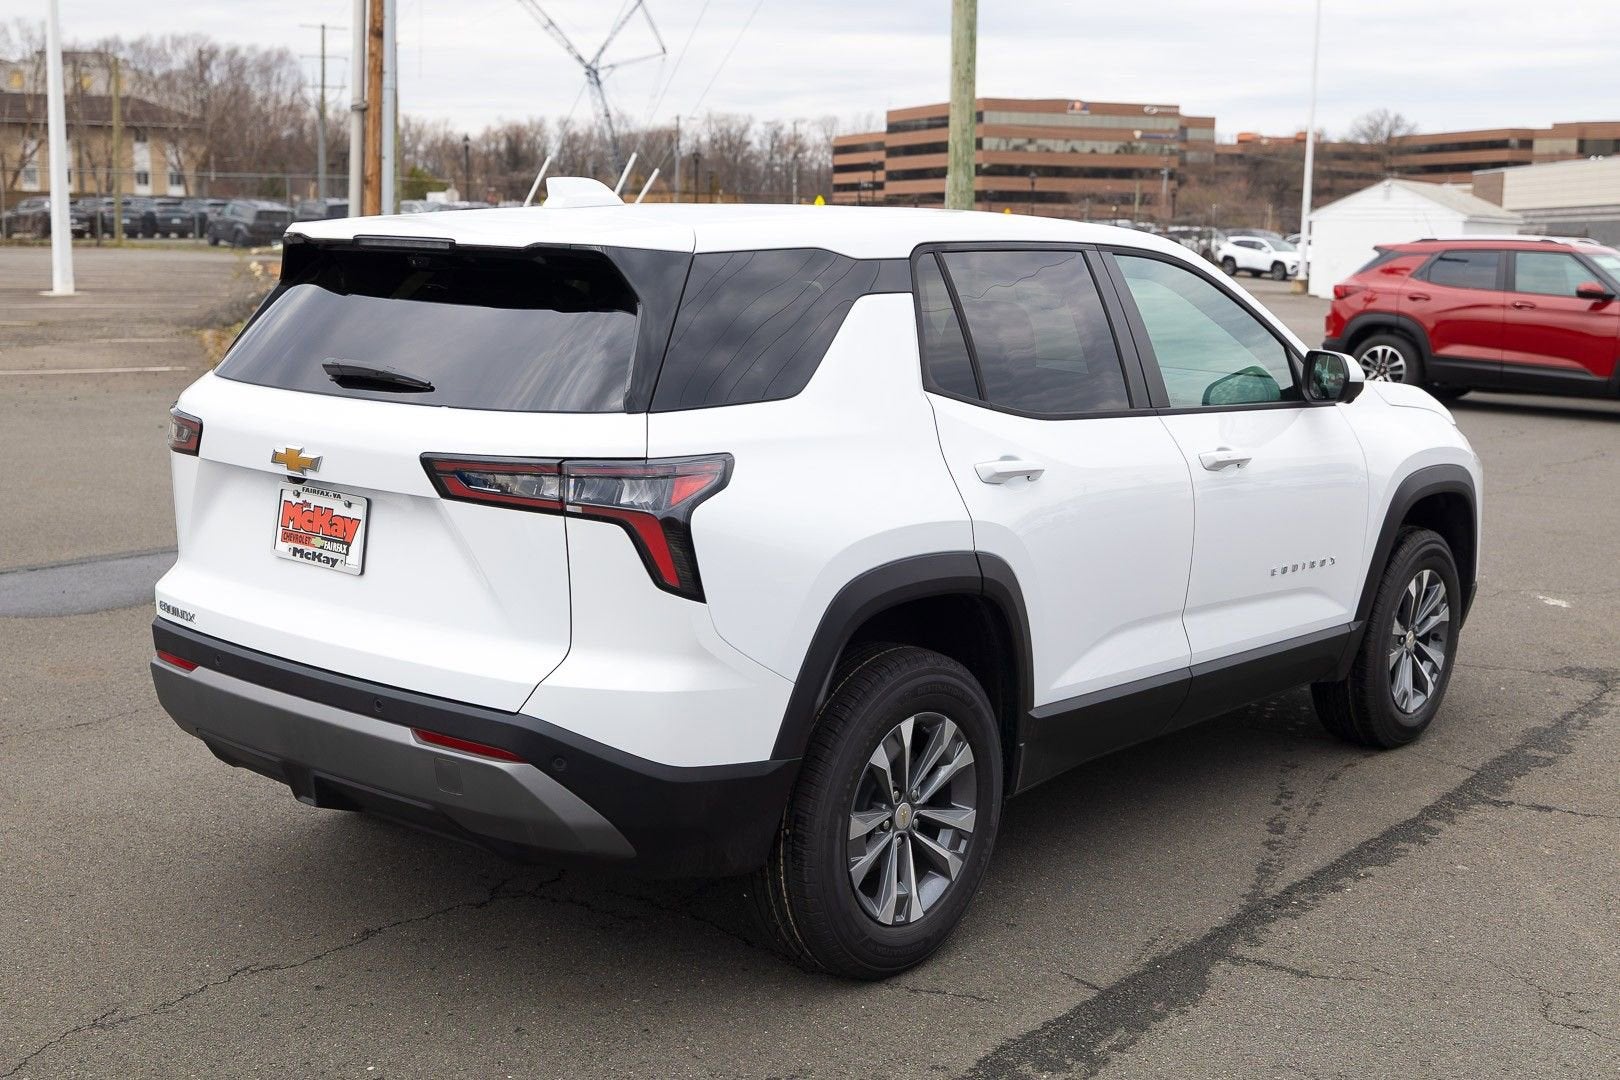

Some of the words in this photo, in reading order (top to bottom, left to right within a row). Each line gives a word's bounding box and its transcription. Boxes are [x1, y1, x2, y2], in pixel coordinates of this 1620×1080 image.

[281, 500, 361, 544] McKay
[282, 531, 313, 547] CHEVROLET
[323, 541, 348, 555] FAIRFAX
[292, 546, 339, 568] McKay
[159, 600, 197, 624] EQUINOX
